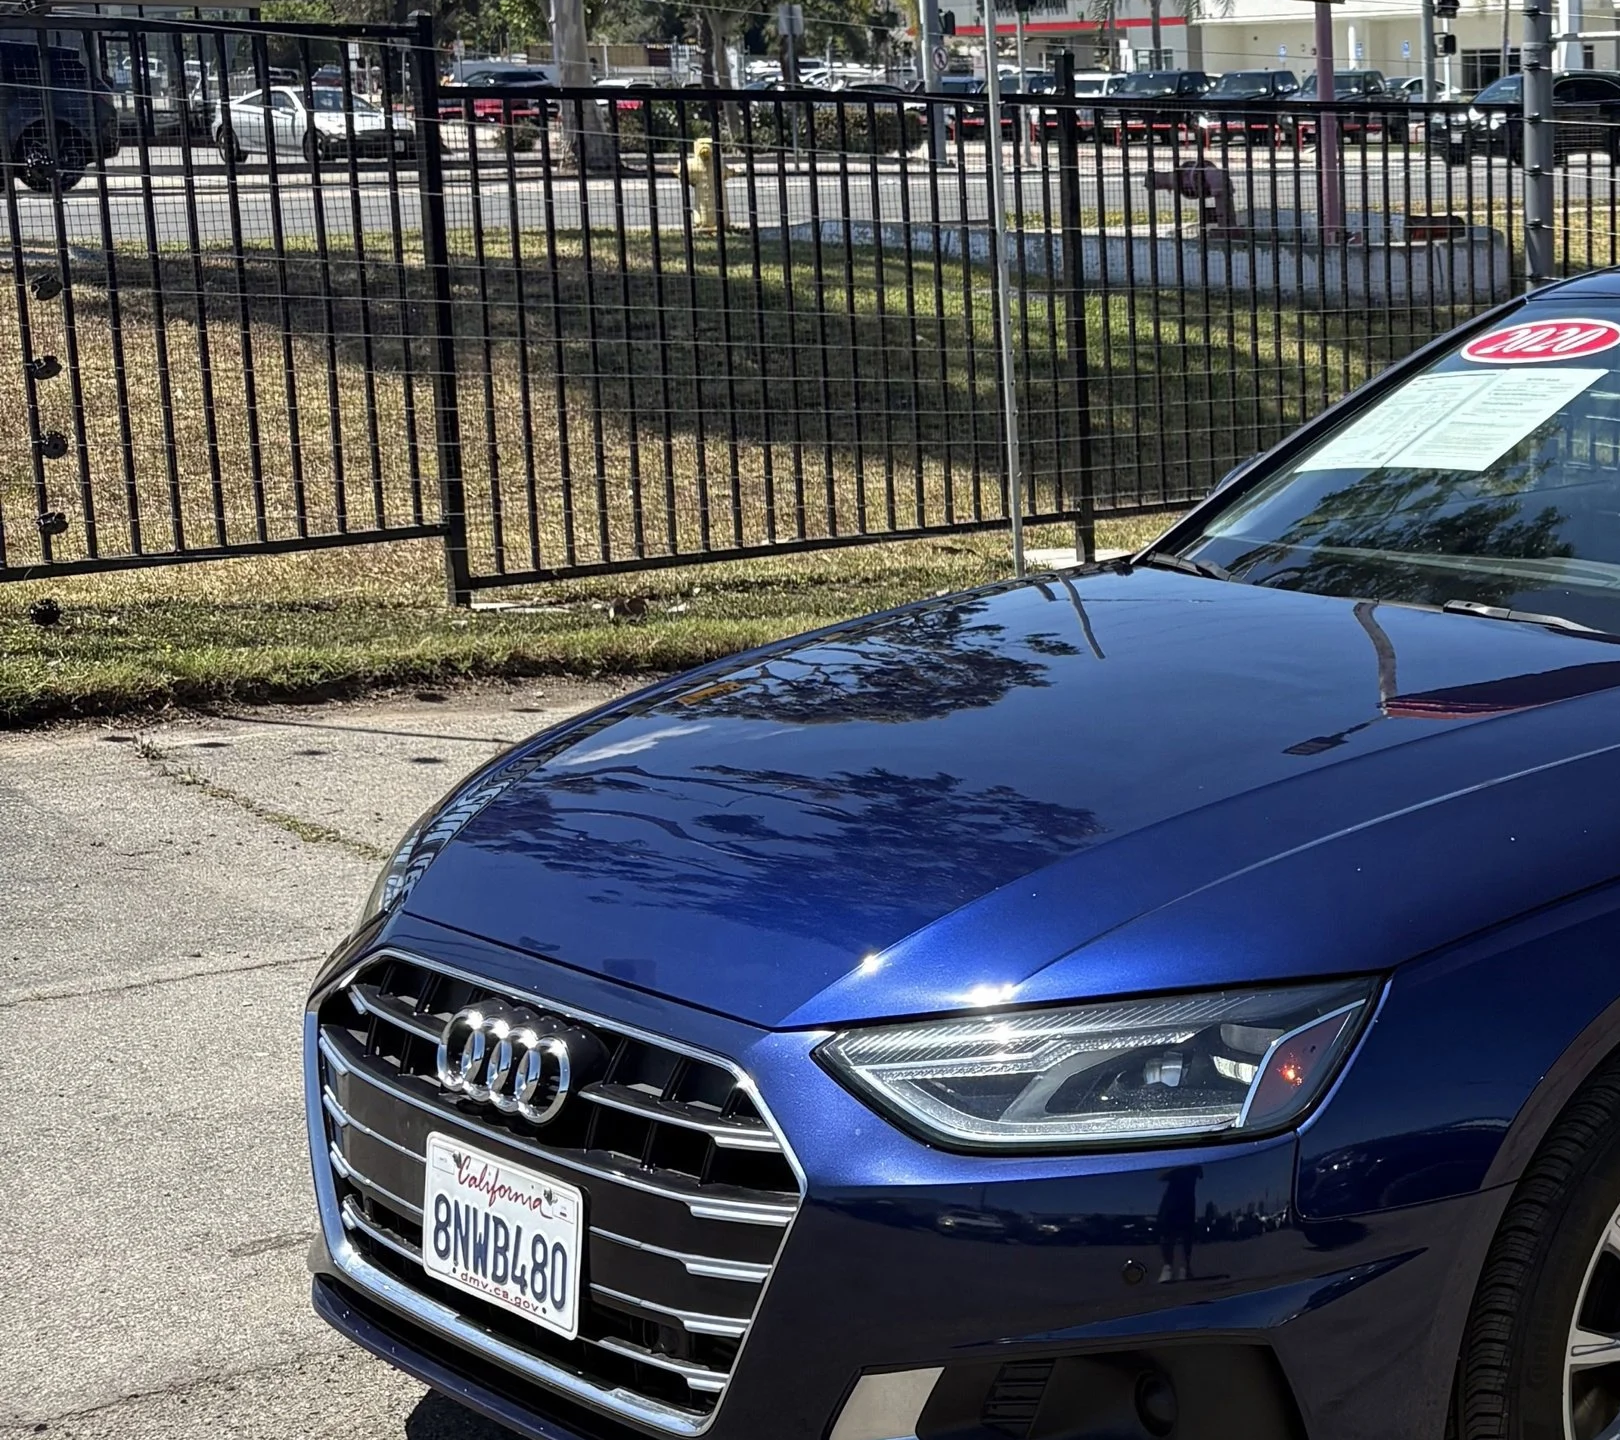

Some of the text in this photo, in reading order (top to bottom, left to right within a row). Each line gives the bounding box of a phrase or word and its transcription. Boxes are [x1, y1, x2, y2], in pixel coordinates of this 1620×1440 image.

[1474, 326, 1609, 355] 2020
[456, 1154, 553, 1220] California
[433, 1193, 568, 1312] 8NWB480
[460, 1271, 540, 1313] dmv.ca.gov
